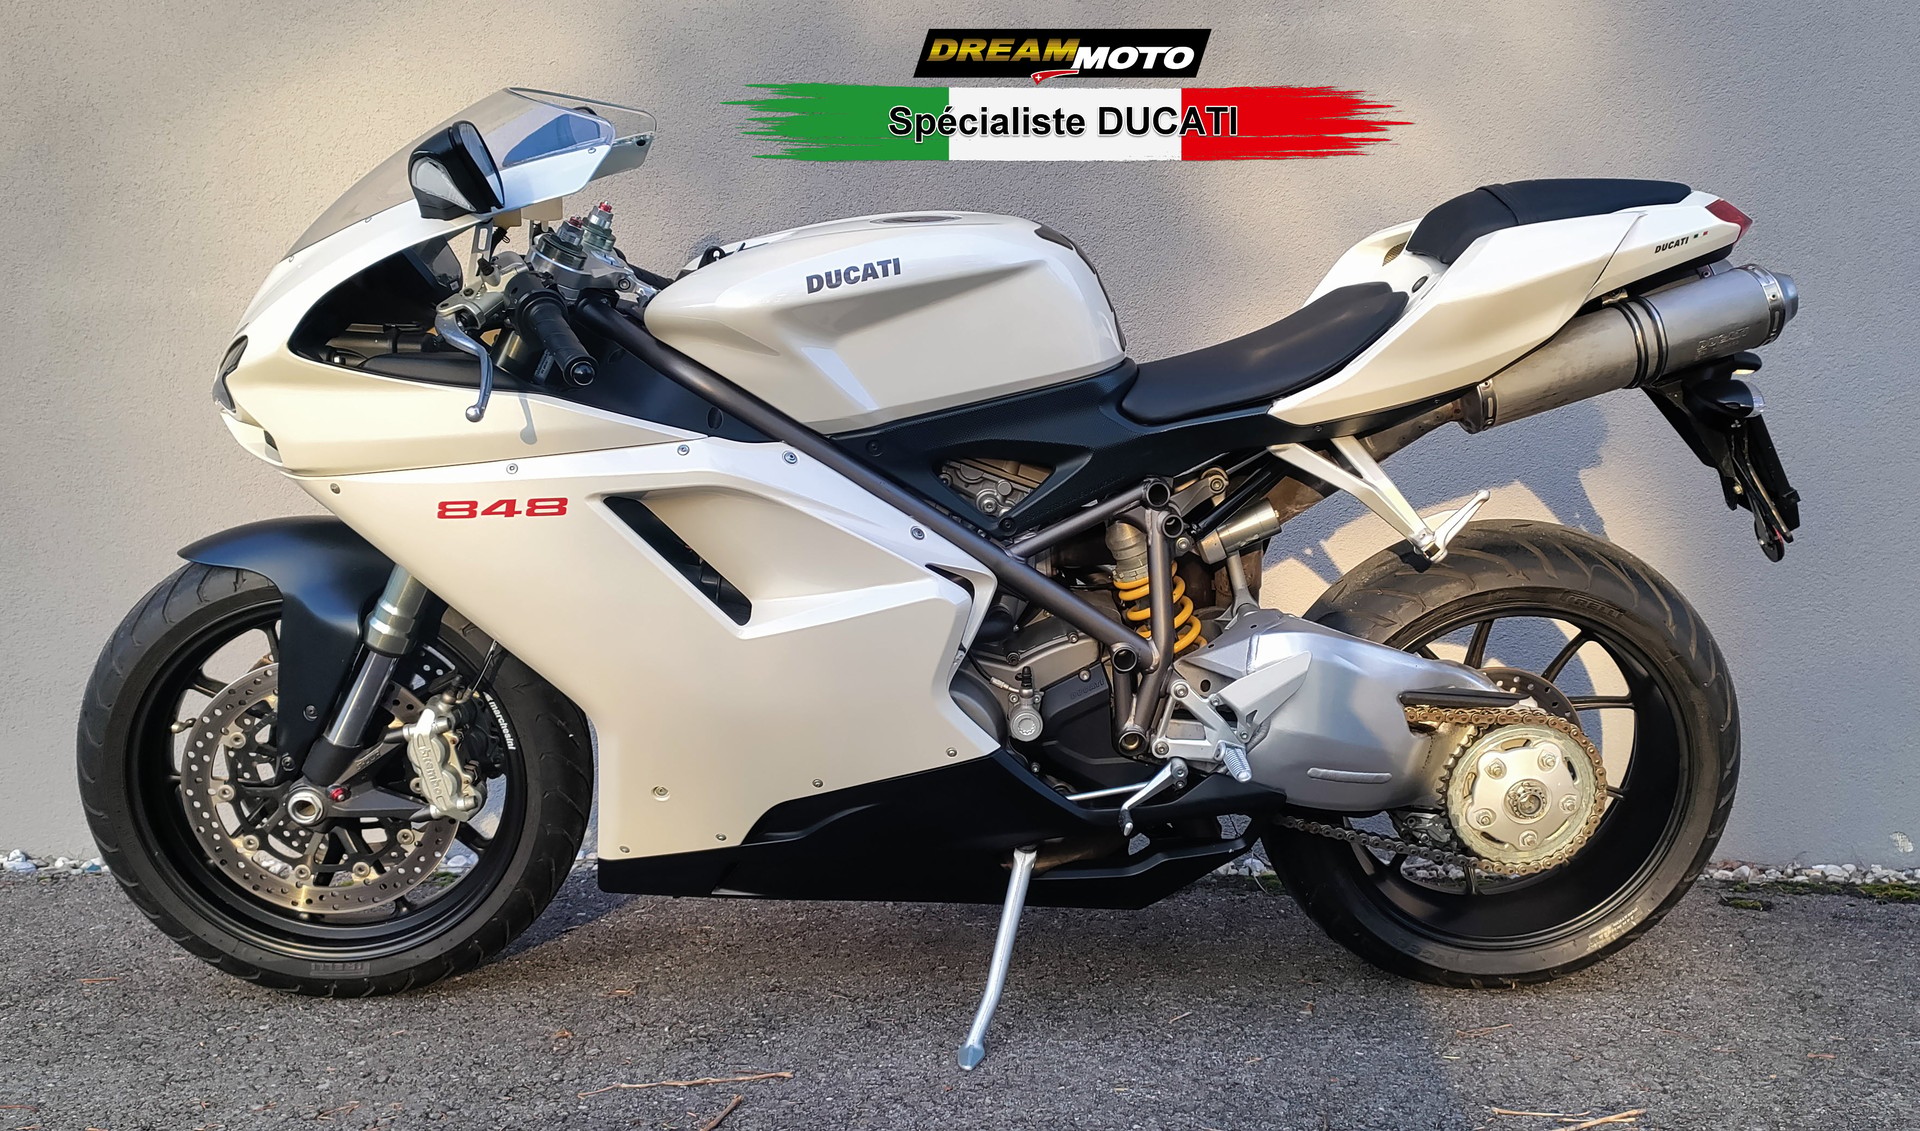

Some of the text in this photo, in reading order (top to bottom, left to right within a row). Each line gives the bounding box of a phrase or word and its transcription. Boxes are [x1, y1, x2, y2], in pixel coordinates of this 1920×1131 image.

[1654, 236, 1689, 254] DUCATI
[806, 257, 901, 294] DUCATI
[437, 497, 568, 519] 848
[488, 700, 517, 750] marchesini
